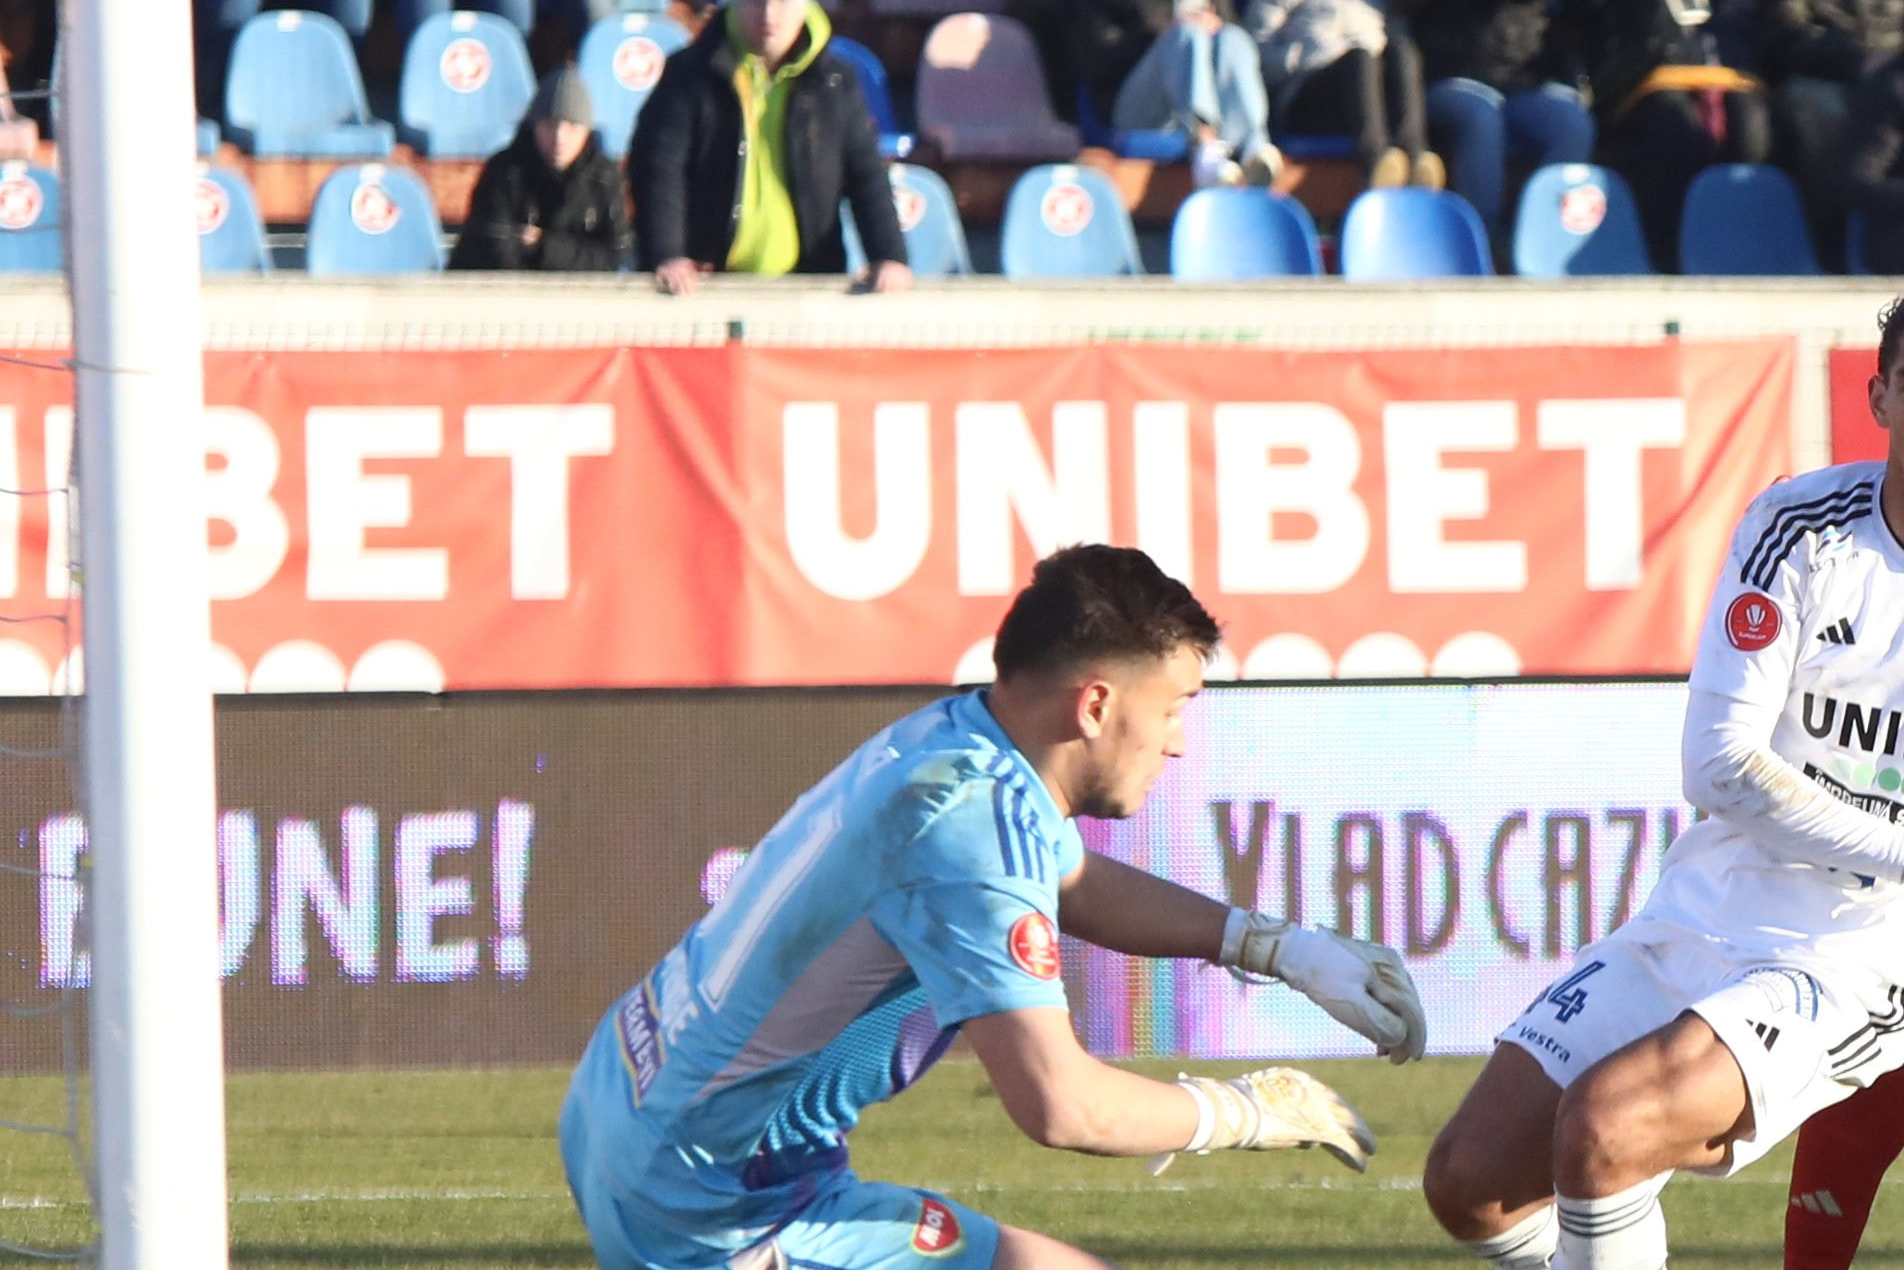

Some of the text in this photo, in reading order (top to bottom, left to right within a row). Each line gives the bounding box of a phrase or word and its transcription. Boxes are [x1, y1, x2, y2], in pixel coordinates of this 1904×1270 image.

[0, 403, 614, 600] BET
[780, 397, 1686, 601] UNIBET
[1210, 800, 1682, 960] VLAD CAZ
[1518, 1025, 1571, 1064] Vestra
